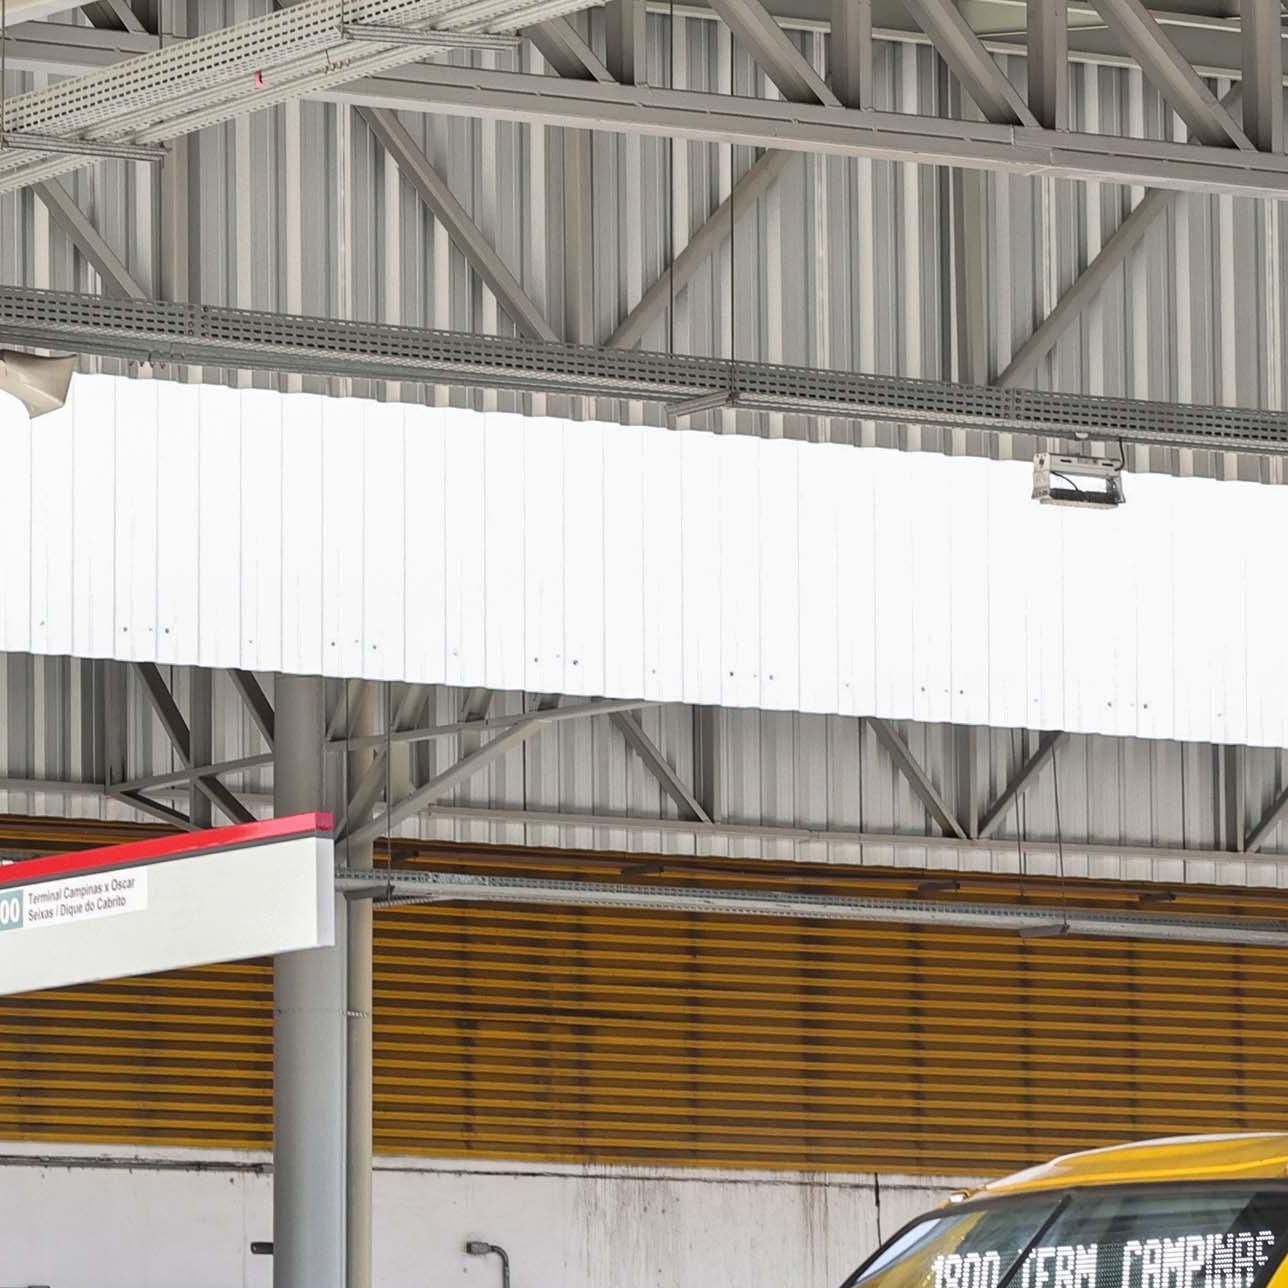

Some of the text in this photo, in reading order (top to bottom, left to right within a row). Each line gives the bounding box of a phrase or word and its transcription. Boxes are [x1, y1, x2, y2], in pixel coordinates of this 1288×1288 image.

[28, 878, 135, 904] Terminal Campinas x Oscar
[28, 909, 53, 921] Seixas
[60, 903, 82, 918] Dique
[84, 901, 95, 912] do
[96, 896, 127, 910] Cabrito
